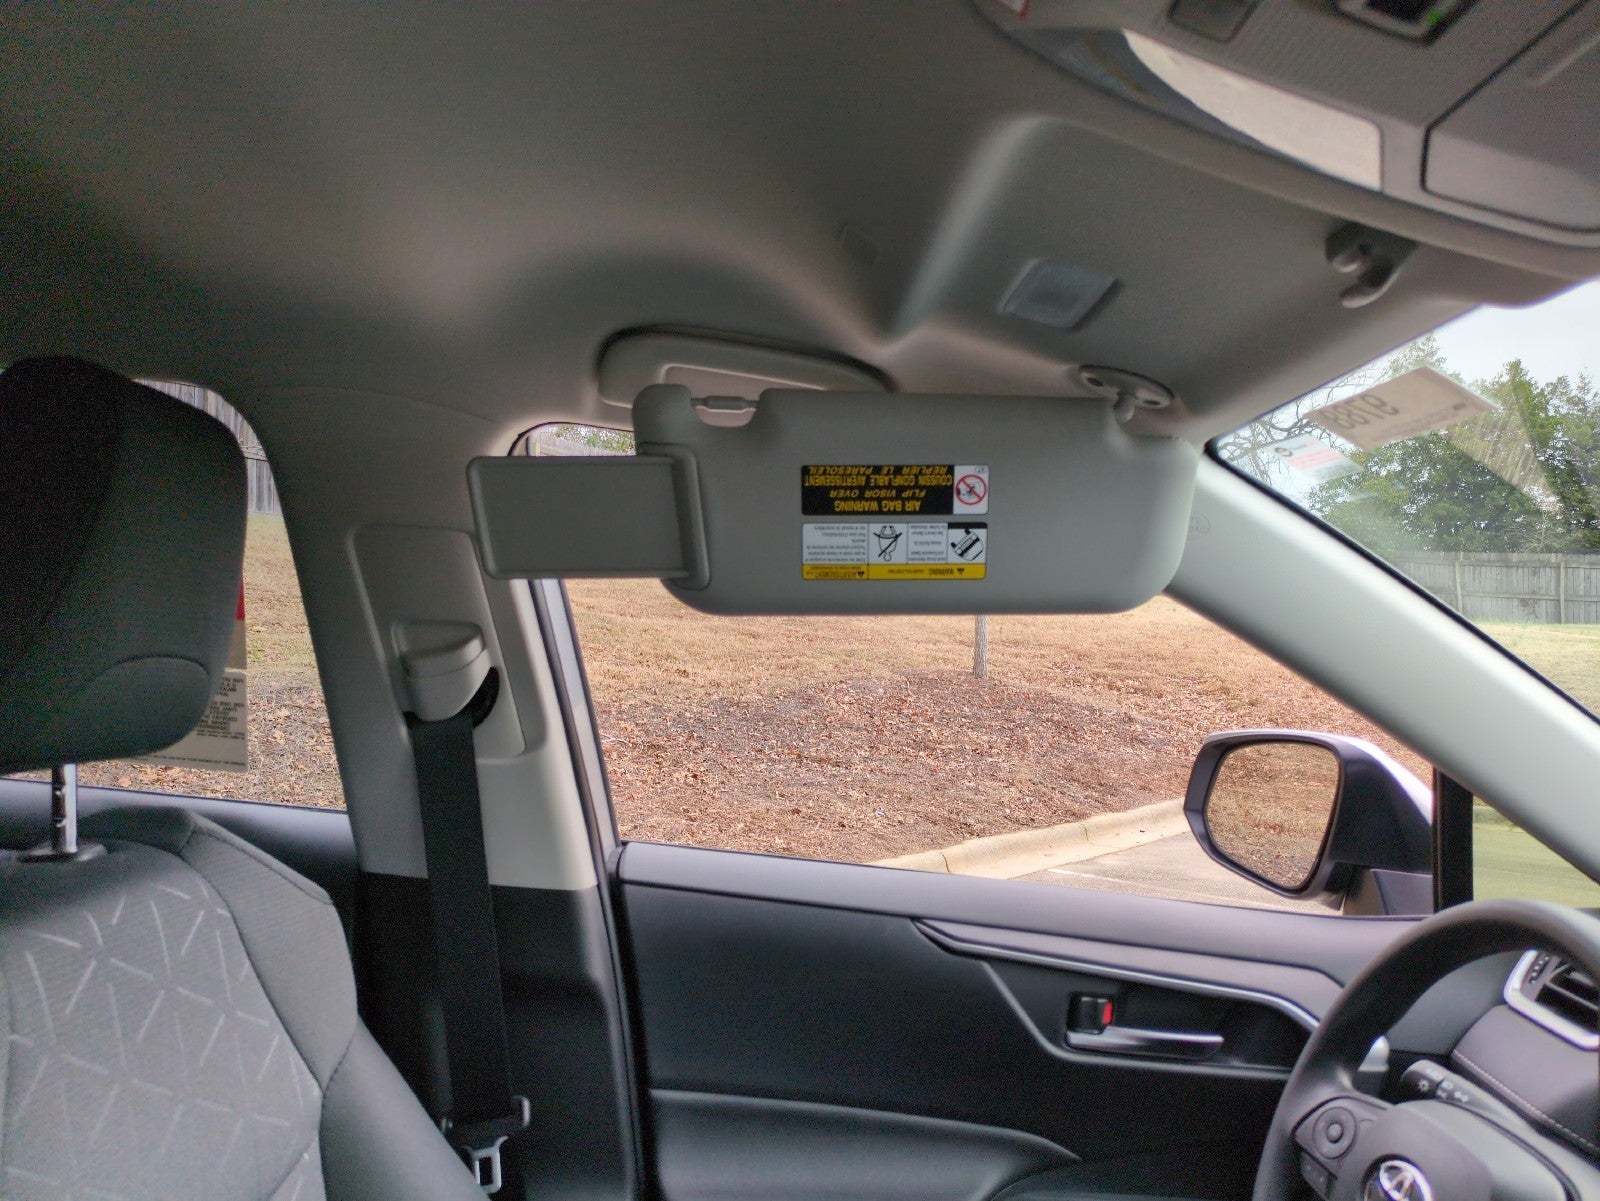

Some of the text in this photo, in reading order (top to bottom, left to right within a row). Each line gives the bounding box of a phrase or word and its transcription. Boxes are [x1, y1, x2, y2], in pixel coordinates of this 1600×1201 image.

[808, 466, 948, 475] REPLIER LE PARESOLEIL
[804, 474, 953, 486] COUSSIN GONFLABLE AVERTISSEMENT
[829, 489, 927, 498] FLIP VISOR OVER
[834, 500, 921, 512] AIR BAG WARNING
[928, 567, 954, 576] WARNING
